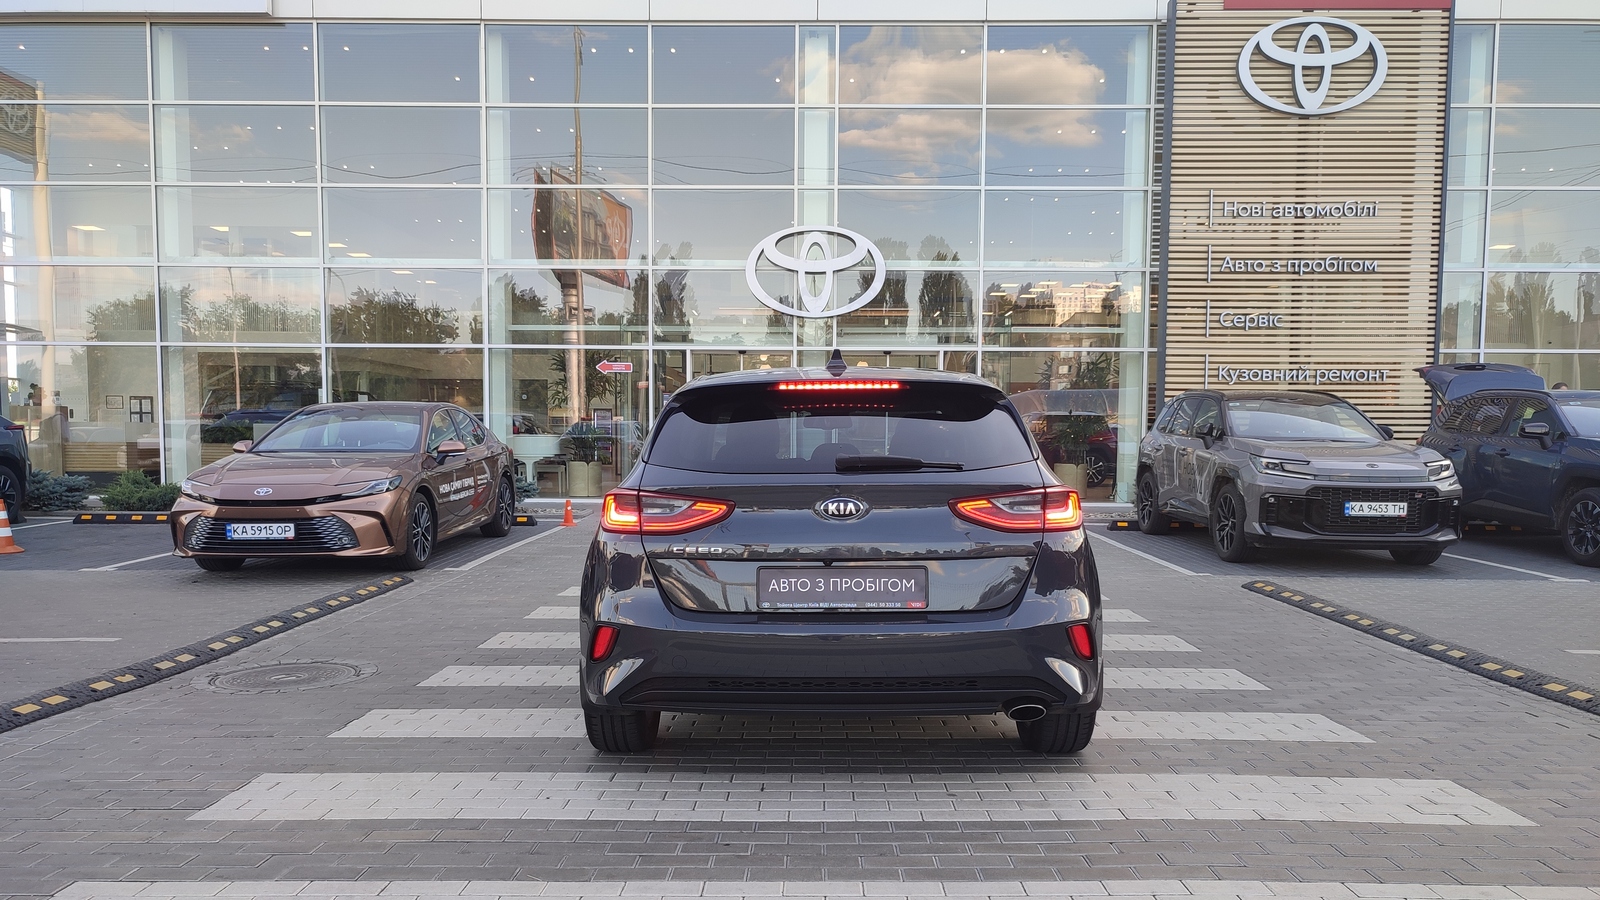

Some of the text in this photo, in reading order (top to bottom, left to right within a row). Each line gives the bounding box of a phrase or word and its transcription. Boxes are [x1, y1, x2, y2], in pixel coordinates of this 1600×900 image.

[1223, 200, 1379, 217] Нові автомобілі
[1220, 255, 1378, 276] Авто з пробігом
[1219, 311, 1284, 331] Сервіс
[1217, 365, 1389, 385] Кузовний ремонт
[828, 502, 857, 515] KIA
[1351, 504, 1405, 513] KA 9453 TH
[233, 525, 292, 536] KA 5915 OP
[768, 578, 915, 592] АВТО З ПРОБІГОМ
